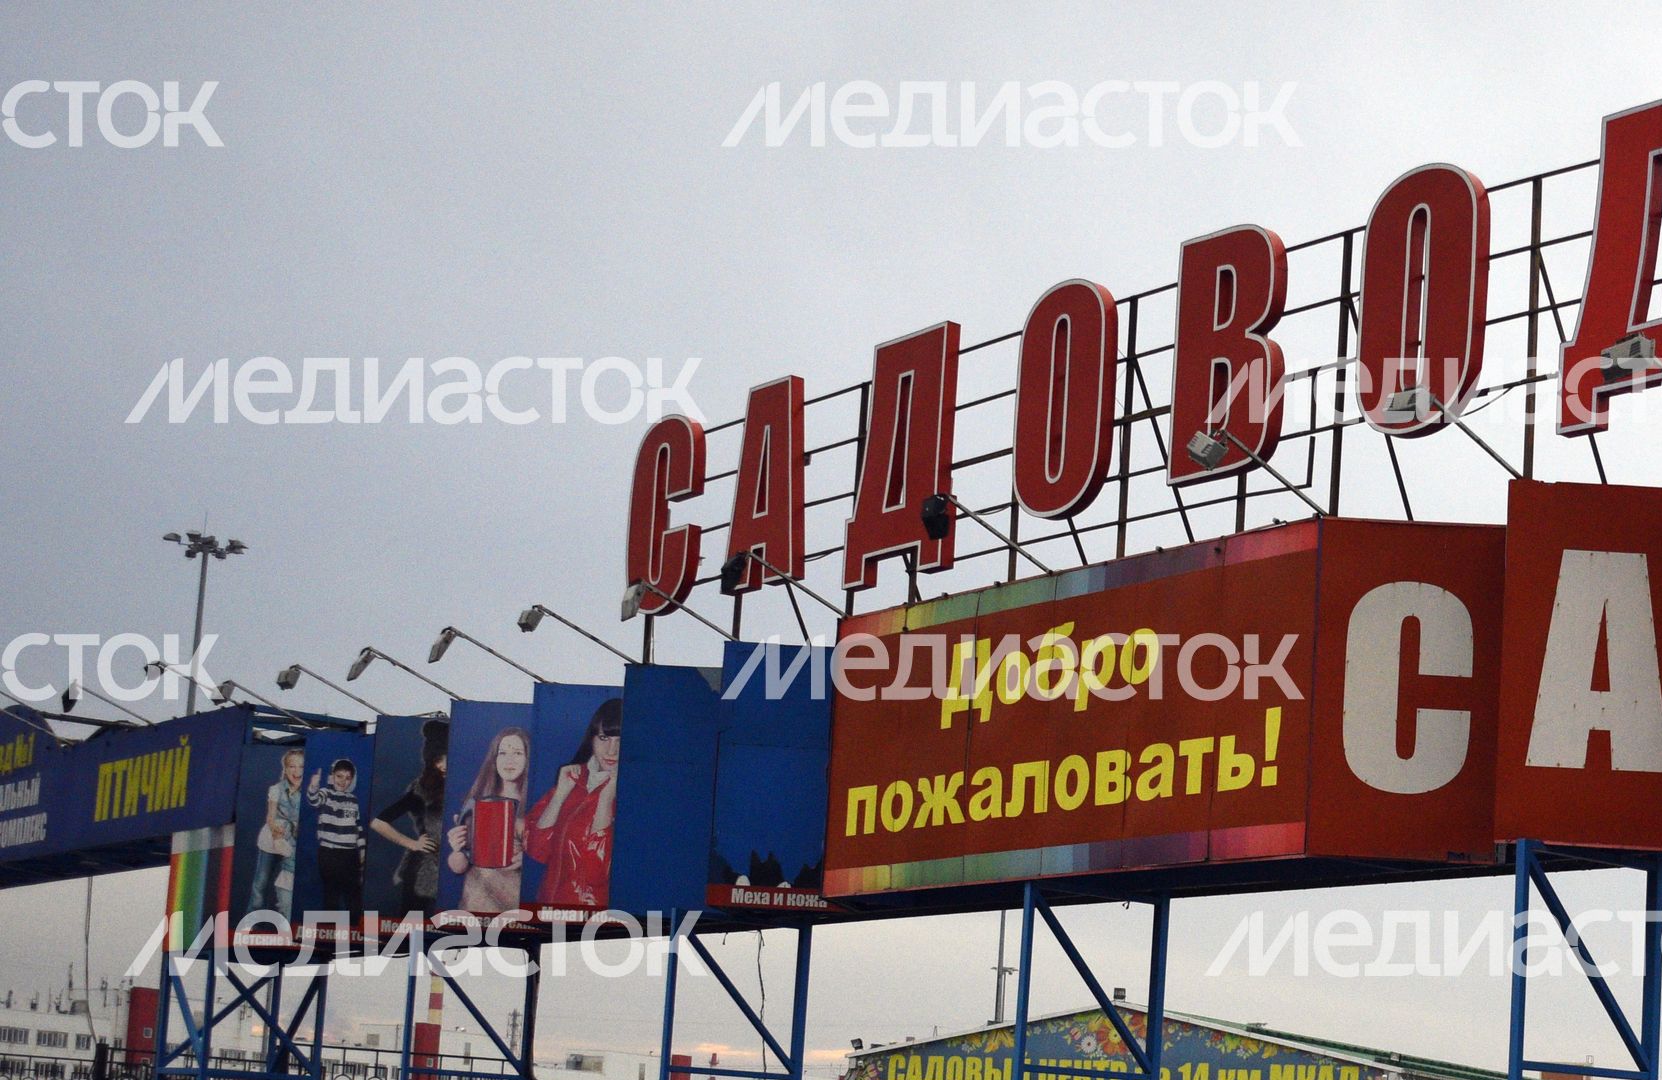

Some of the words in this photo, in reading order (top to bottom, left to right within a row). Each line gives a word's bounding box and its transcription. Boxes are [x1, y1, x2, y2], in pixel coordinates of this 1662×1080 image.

[940, 621, 1159, 729] Добро
[94, 734, 191, 822] ПТИЧИЙ
[845, 706, 1281, 837] пожаловать!
[731, 887, 769, 905] Меха
[773, 892, 783, 906] и
